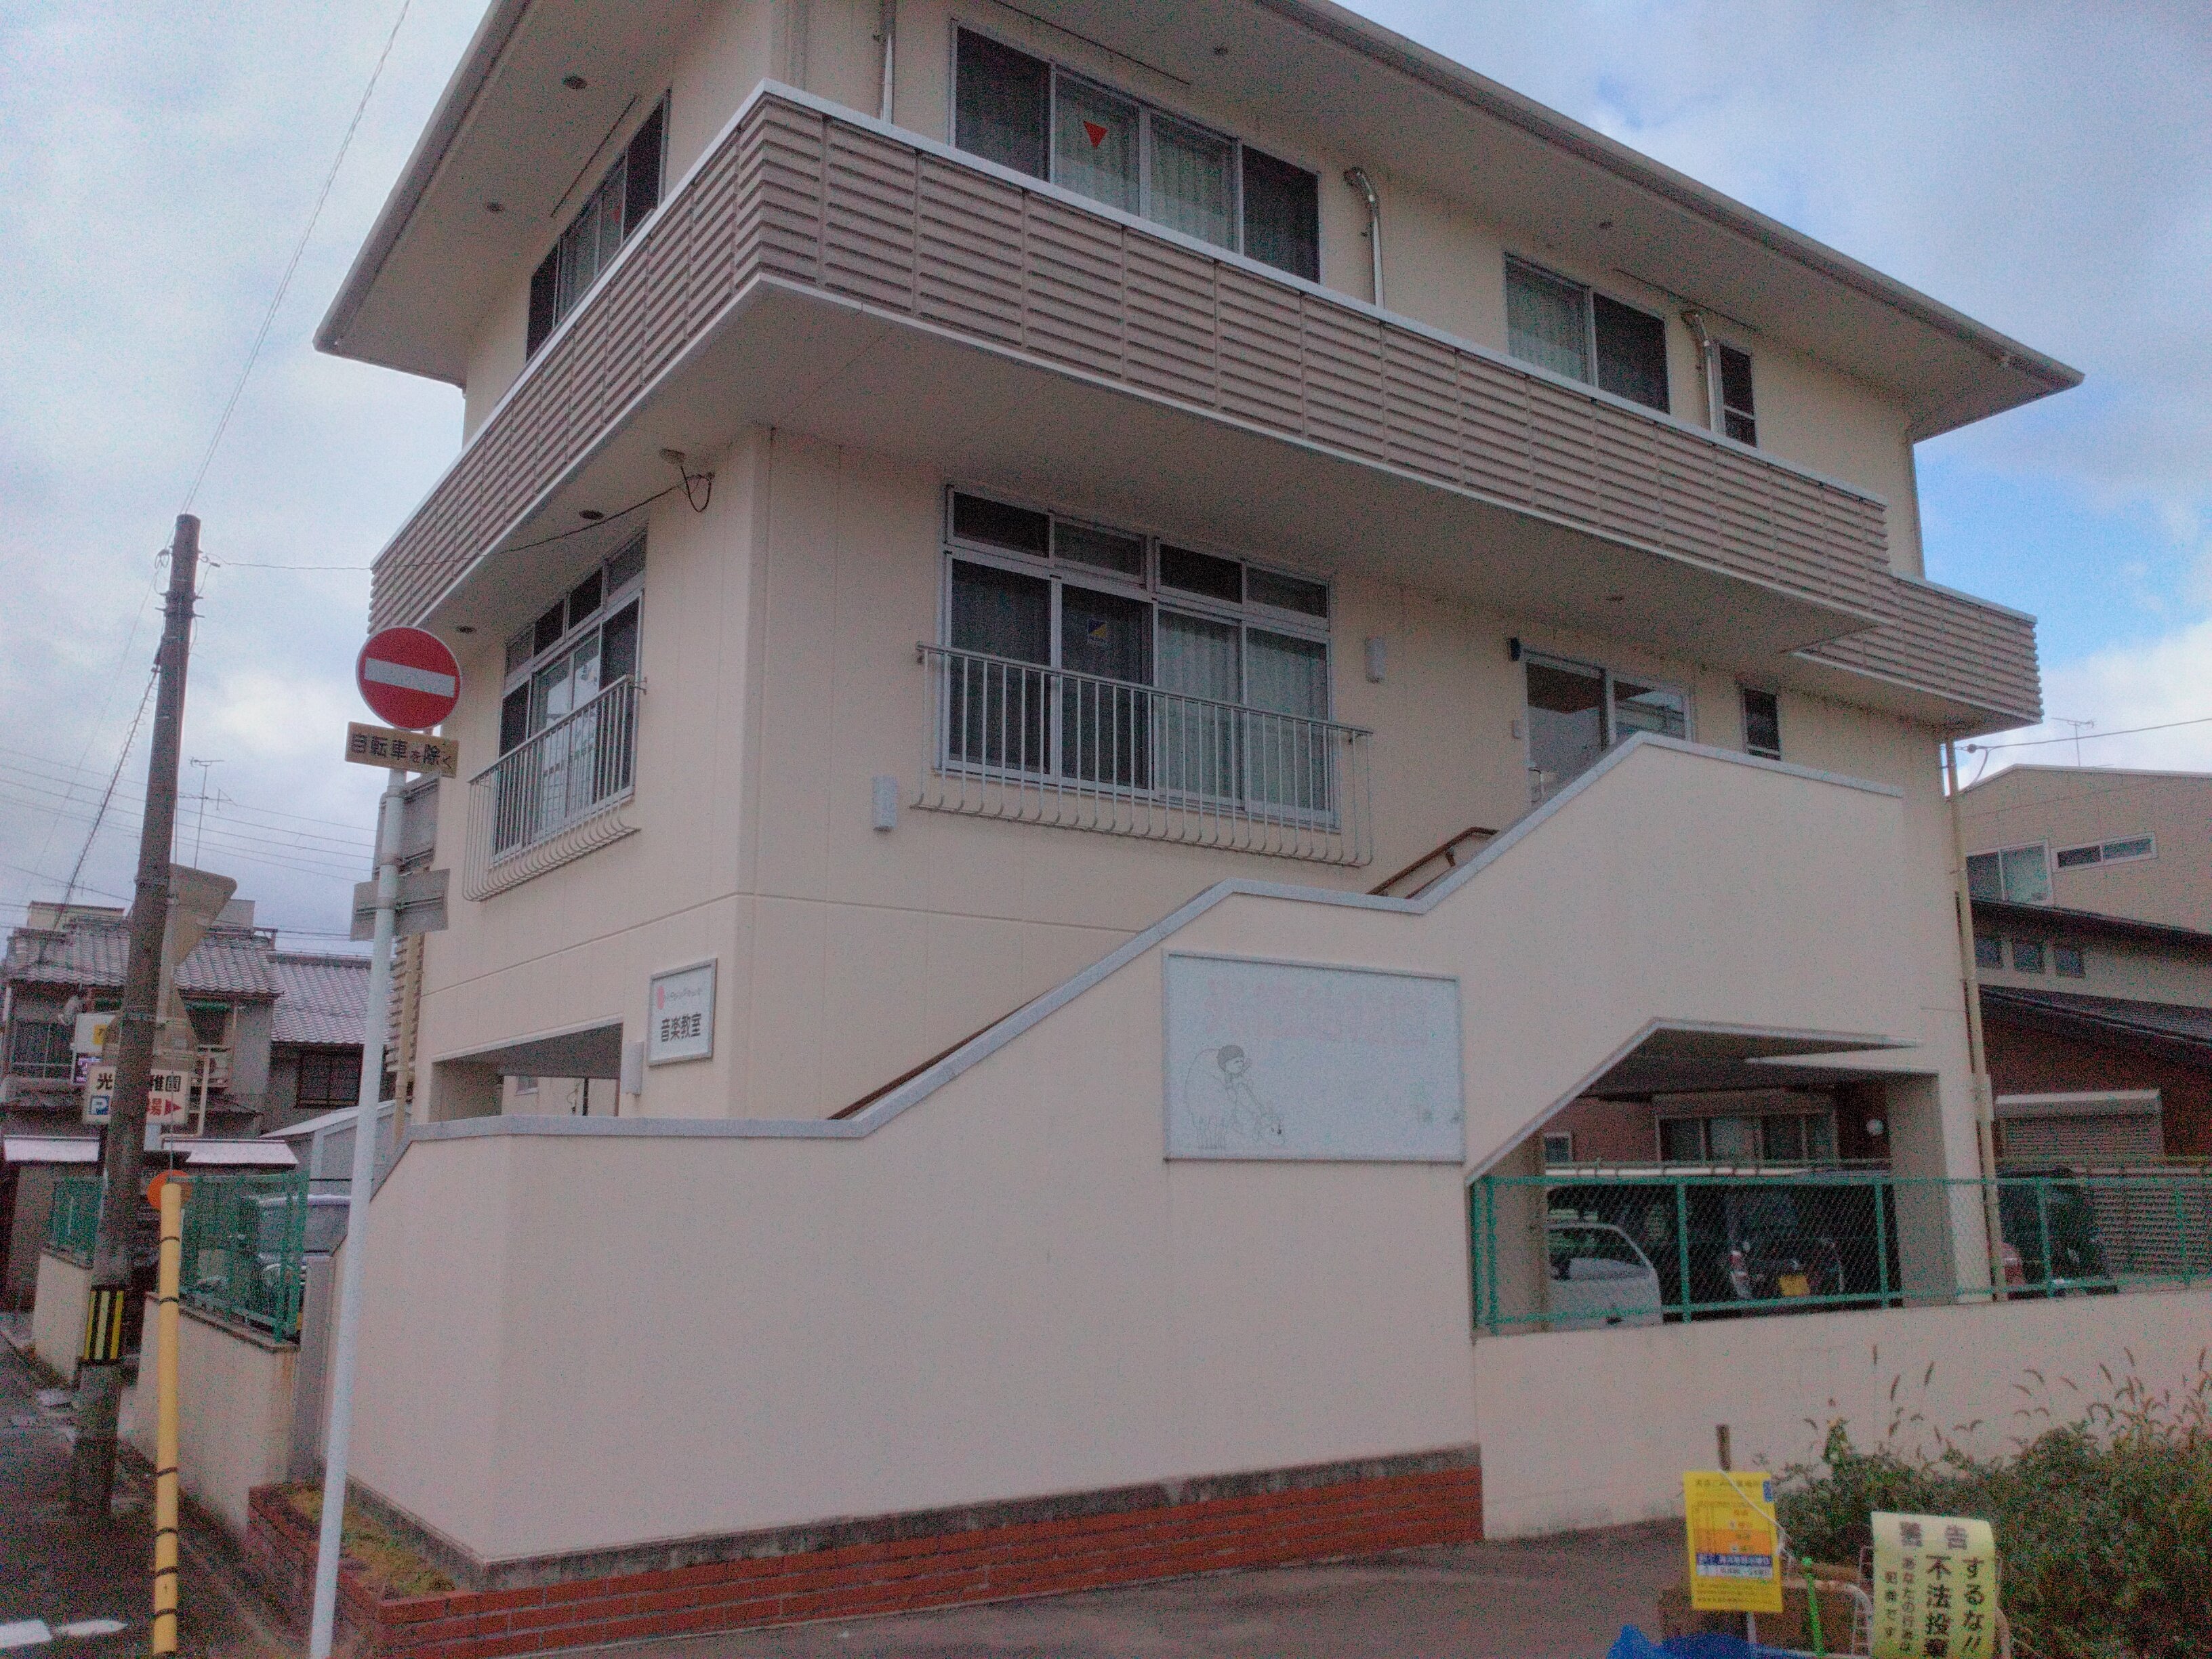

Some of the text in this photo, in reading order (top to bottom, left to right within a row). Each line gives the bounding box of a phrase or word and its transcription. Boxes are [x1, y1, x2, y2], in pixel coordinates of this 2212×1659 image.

[350, 733, 452, 769] 自転車を除く
[661, 1012, 701, 1042] 音楽教室
